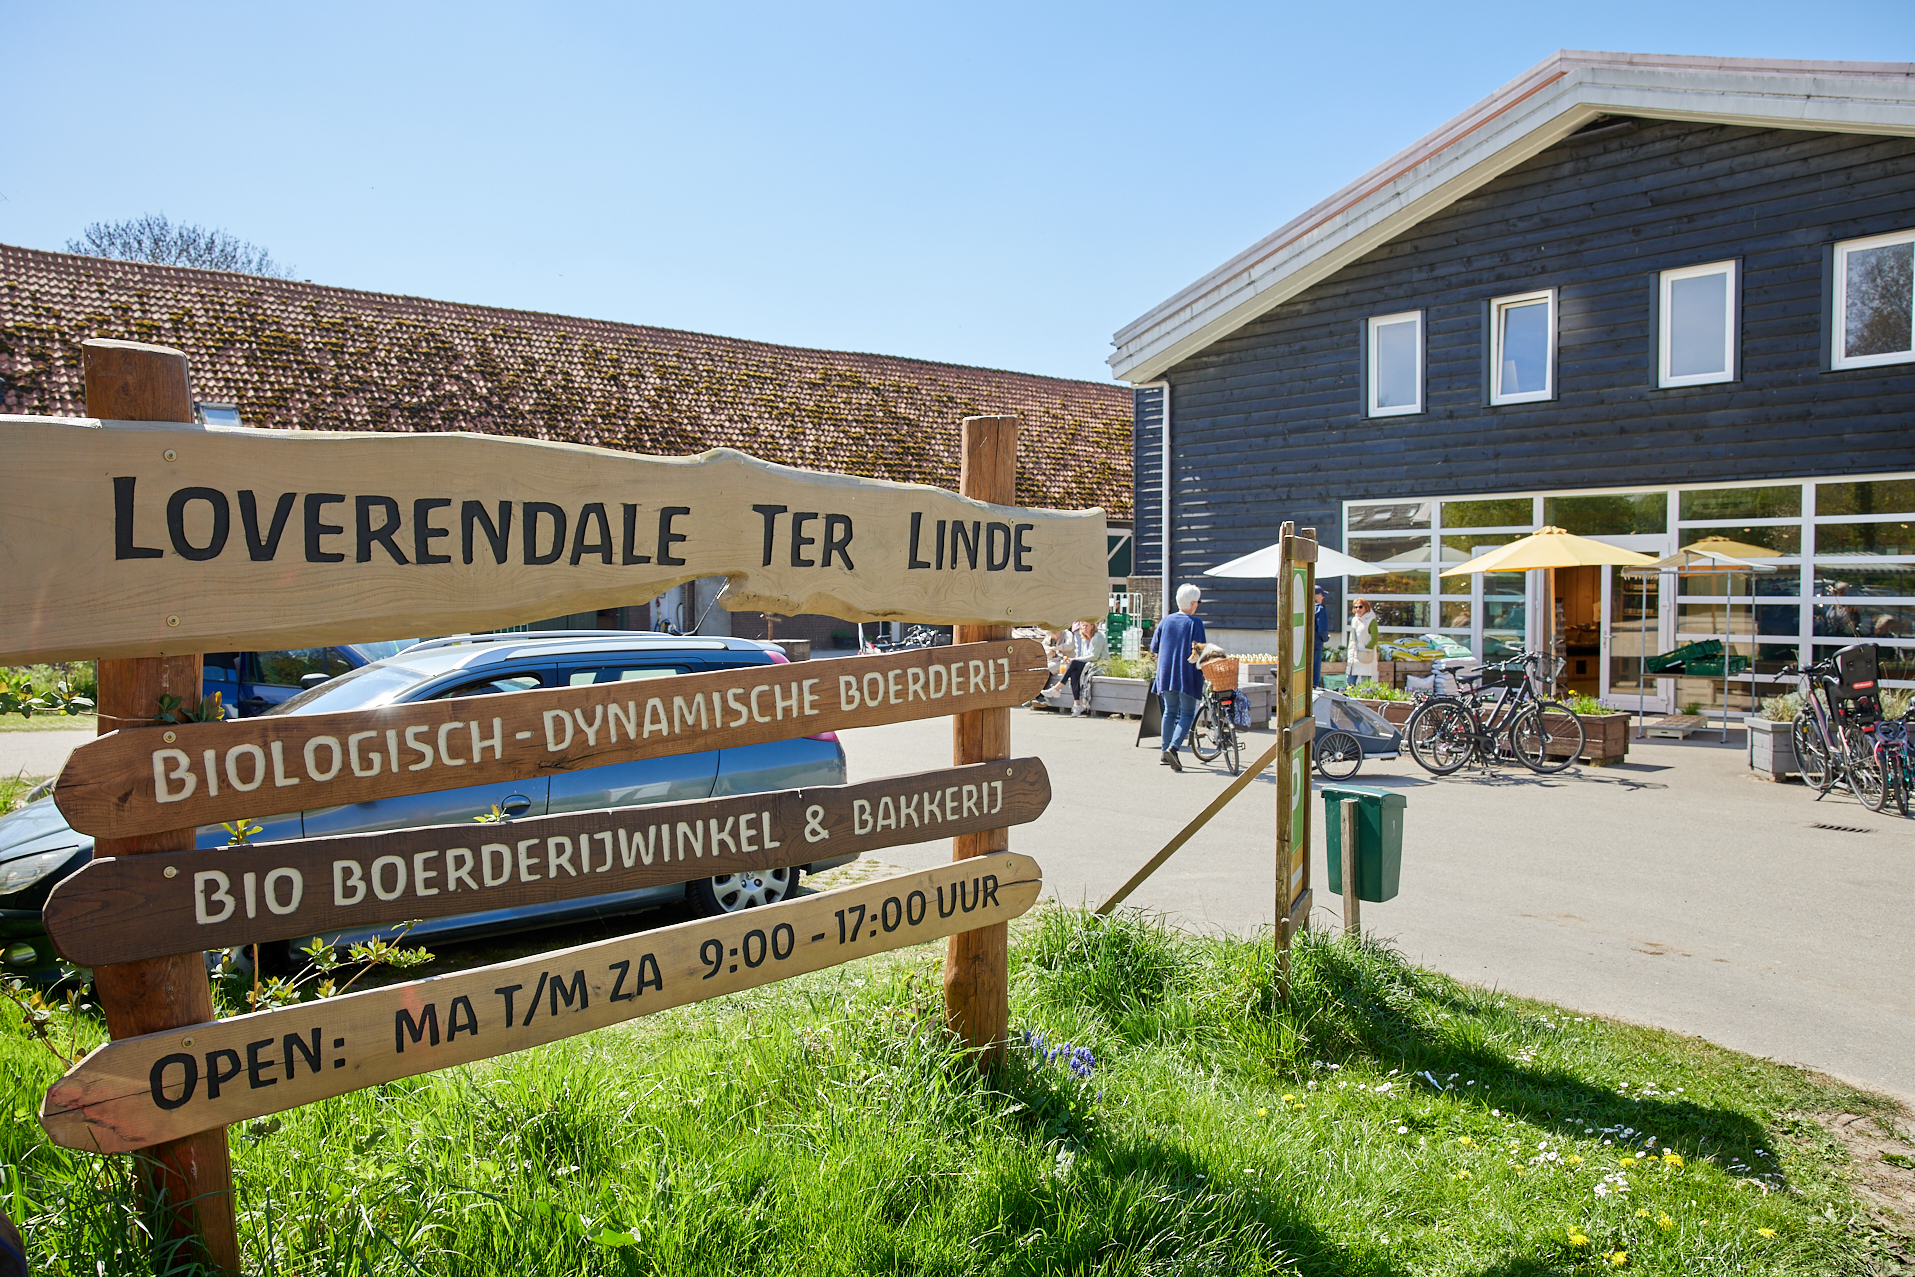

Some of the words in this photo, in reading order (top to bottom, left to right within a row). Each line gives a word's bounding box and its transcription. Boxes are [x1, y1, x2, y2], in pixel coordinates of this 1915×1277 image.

[113, 476, 691, 567] LOVERENDALE
[752, 504, 855, 571] TER
[908, 511, 1034, 572] LINDE
[839, 657, 1010, 712] BOERDERIJ
[194, 866, 304, 926] BIO
[333, 811, 781, 907] BOERDERIJWINKEL
[804, 804, 830, 843] &
[853, 780, 1003, 836] BAKKERIJ
[149, 1027, 346, 1111] OPEN:
[395, 995, 479, 1055] MA
[495, 970, 589, 1028] T/M
[609, 952, 663, 1003] ZA
[700, 922, 795, 981] 9:00
[936, 874, 1000, 919] UUR
